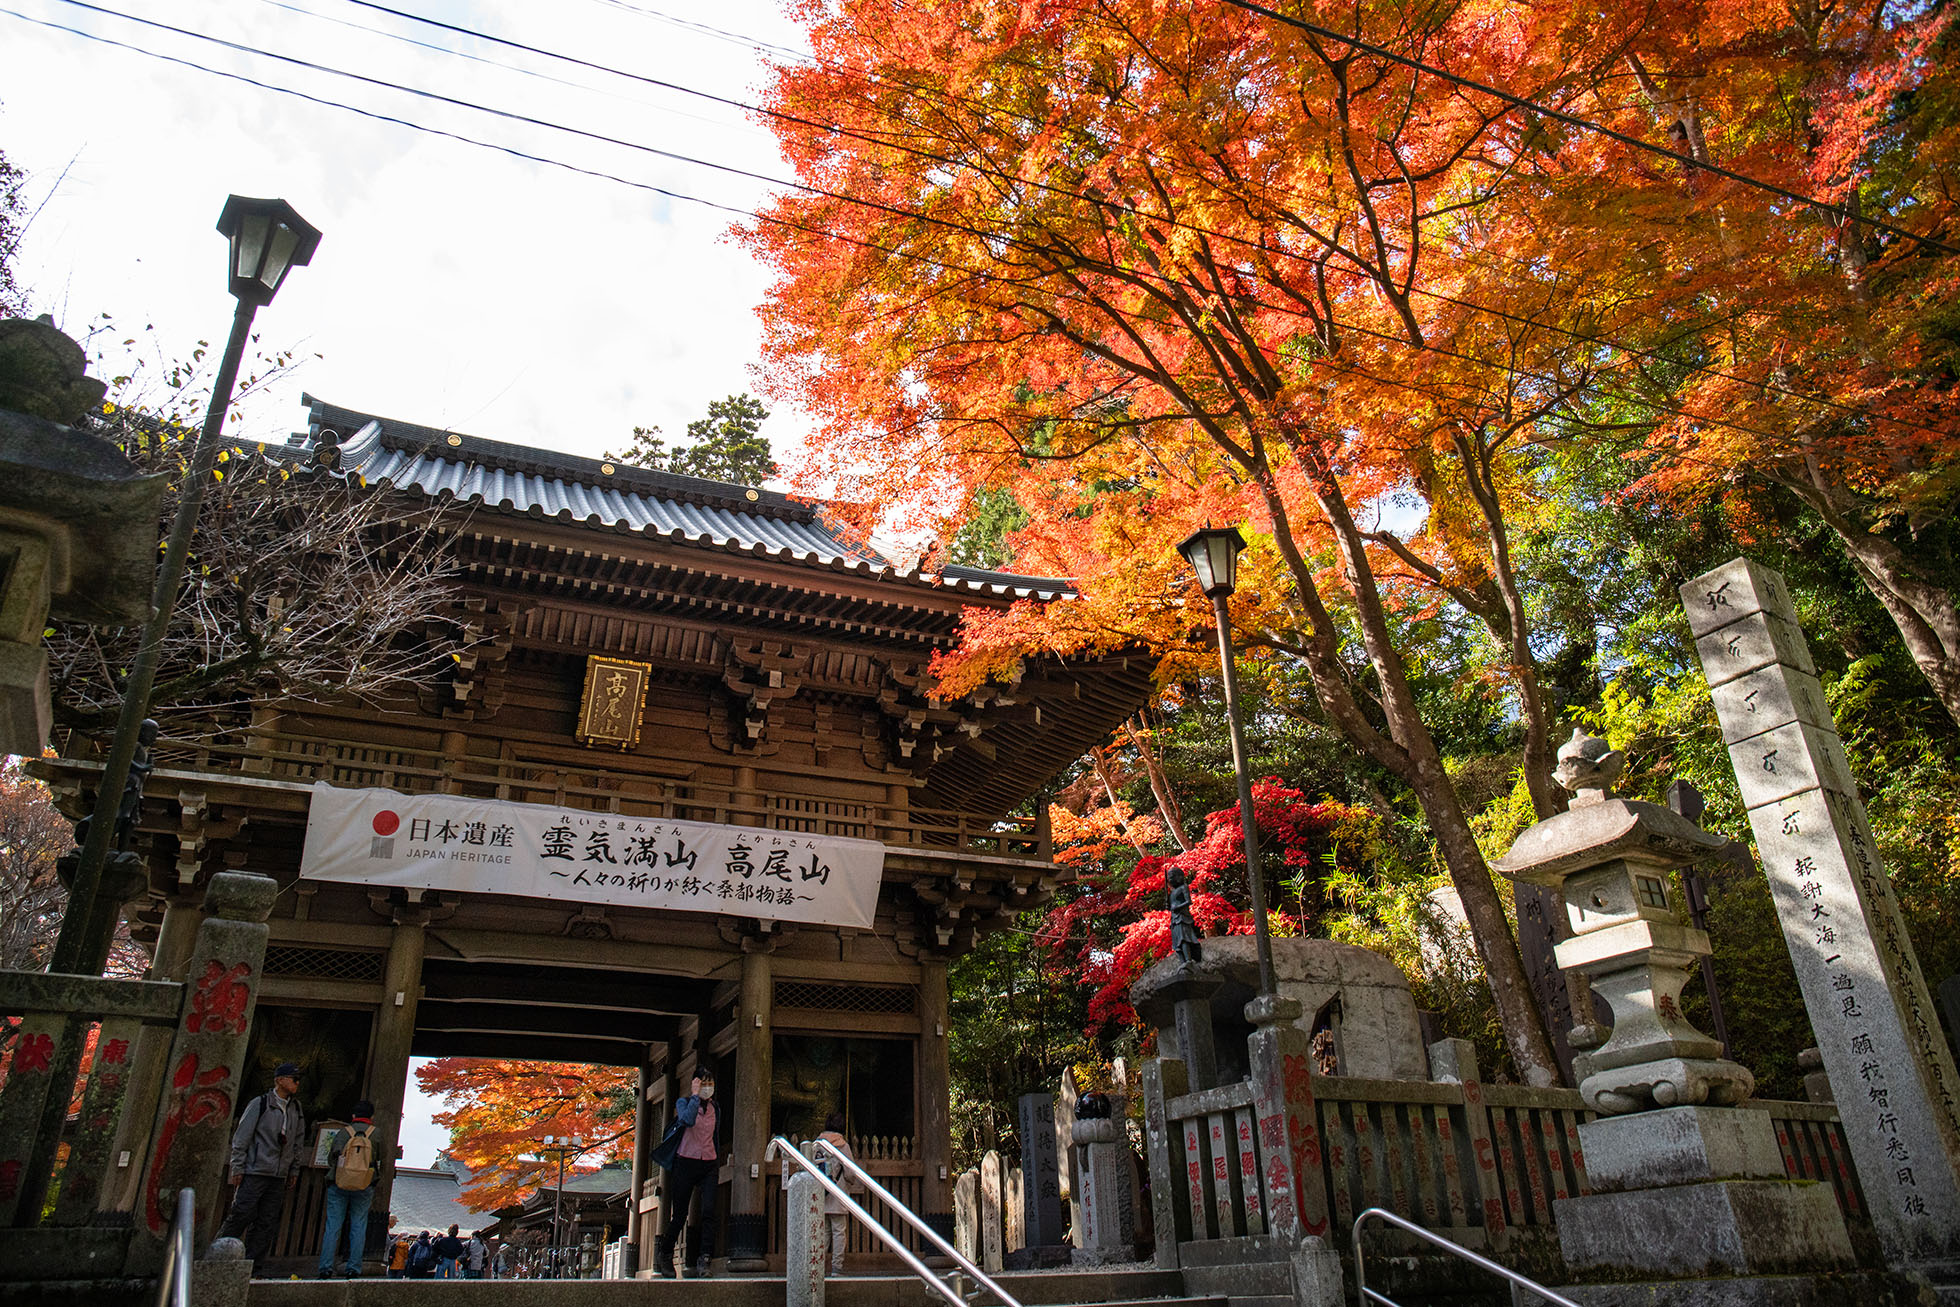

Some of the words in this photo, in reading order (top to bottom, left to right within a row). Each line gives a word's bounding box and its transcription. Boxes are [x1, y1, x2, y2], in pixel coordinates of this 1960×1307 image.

[408, 817, 516, 848] 日本遺産
[560, 815, 682, 837] れいきまんざん
[736, 833, 816, 850] たかおさん
[406, 848, 446, 860] JAPAN
[451, 851, 512, 865] HERITAGE
[540, 826, 698, 871] 霊気満山
[725, 843, 831, 886] 高尾山
